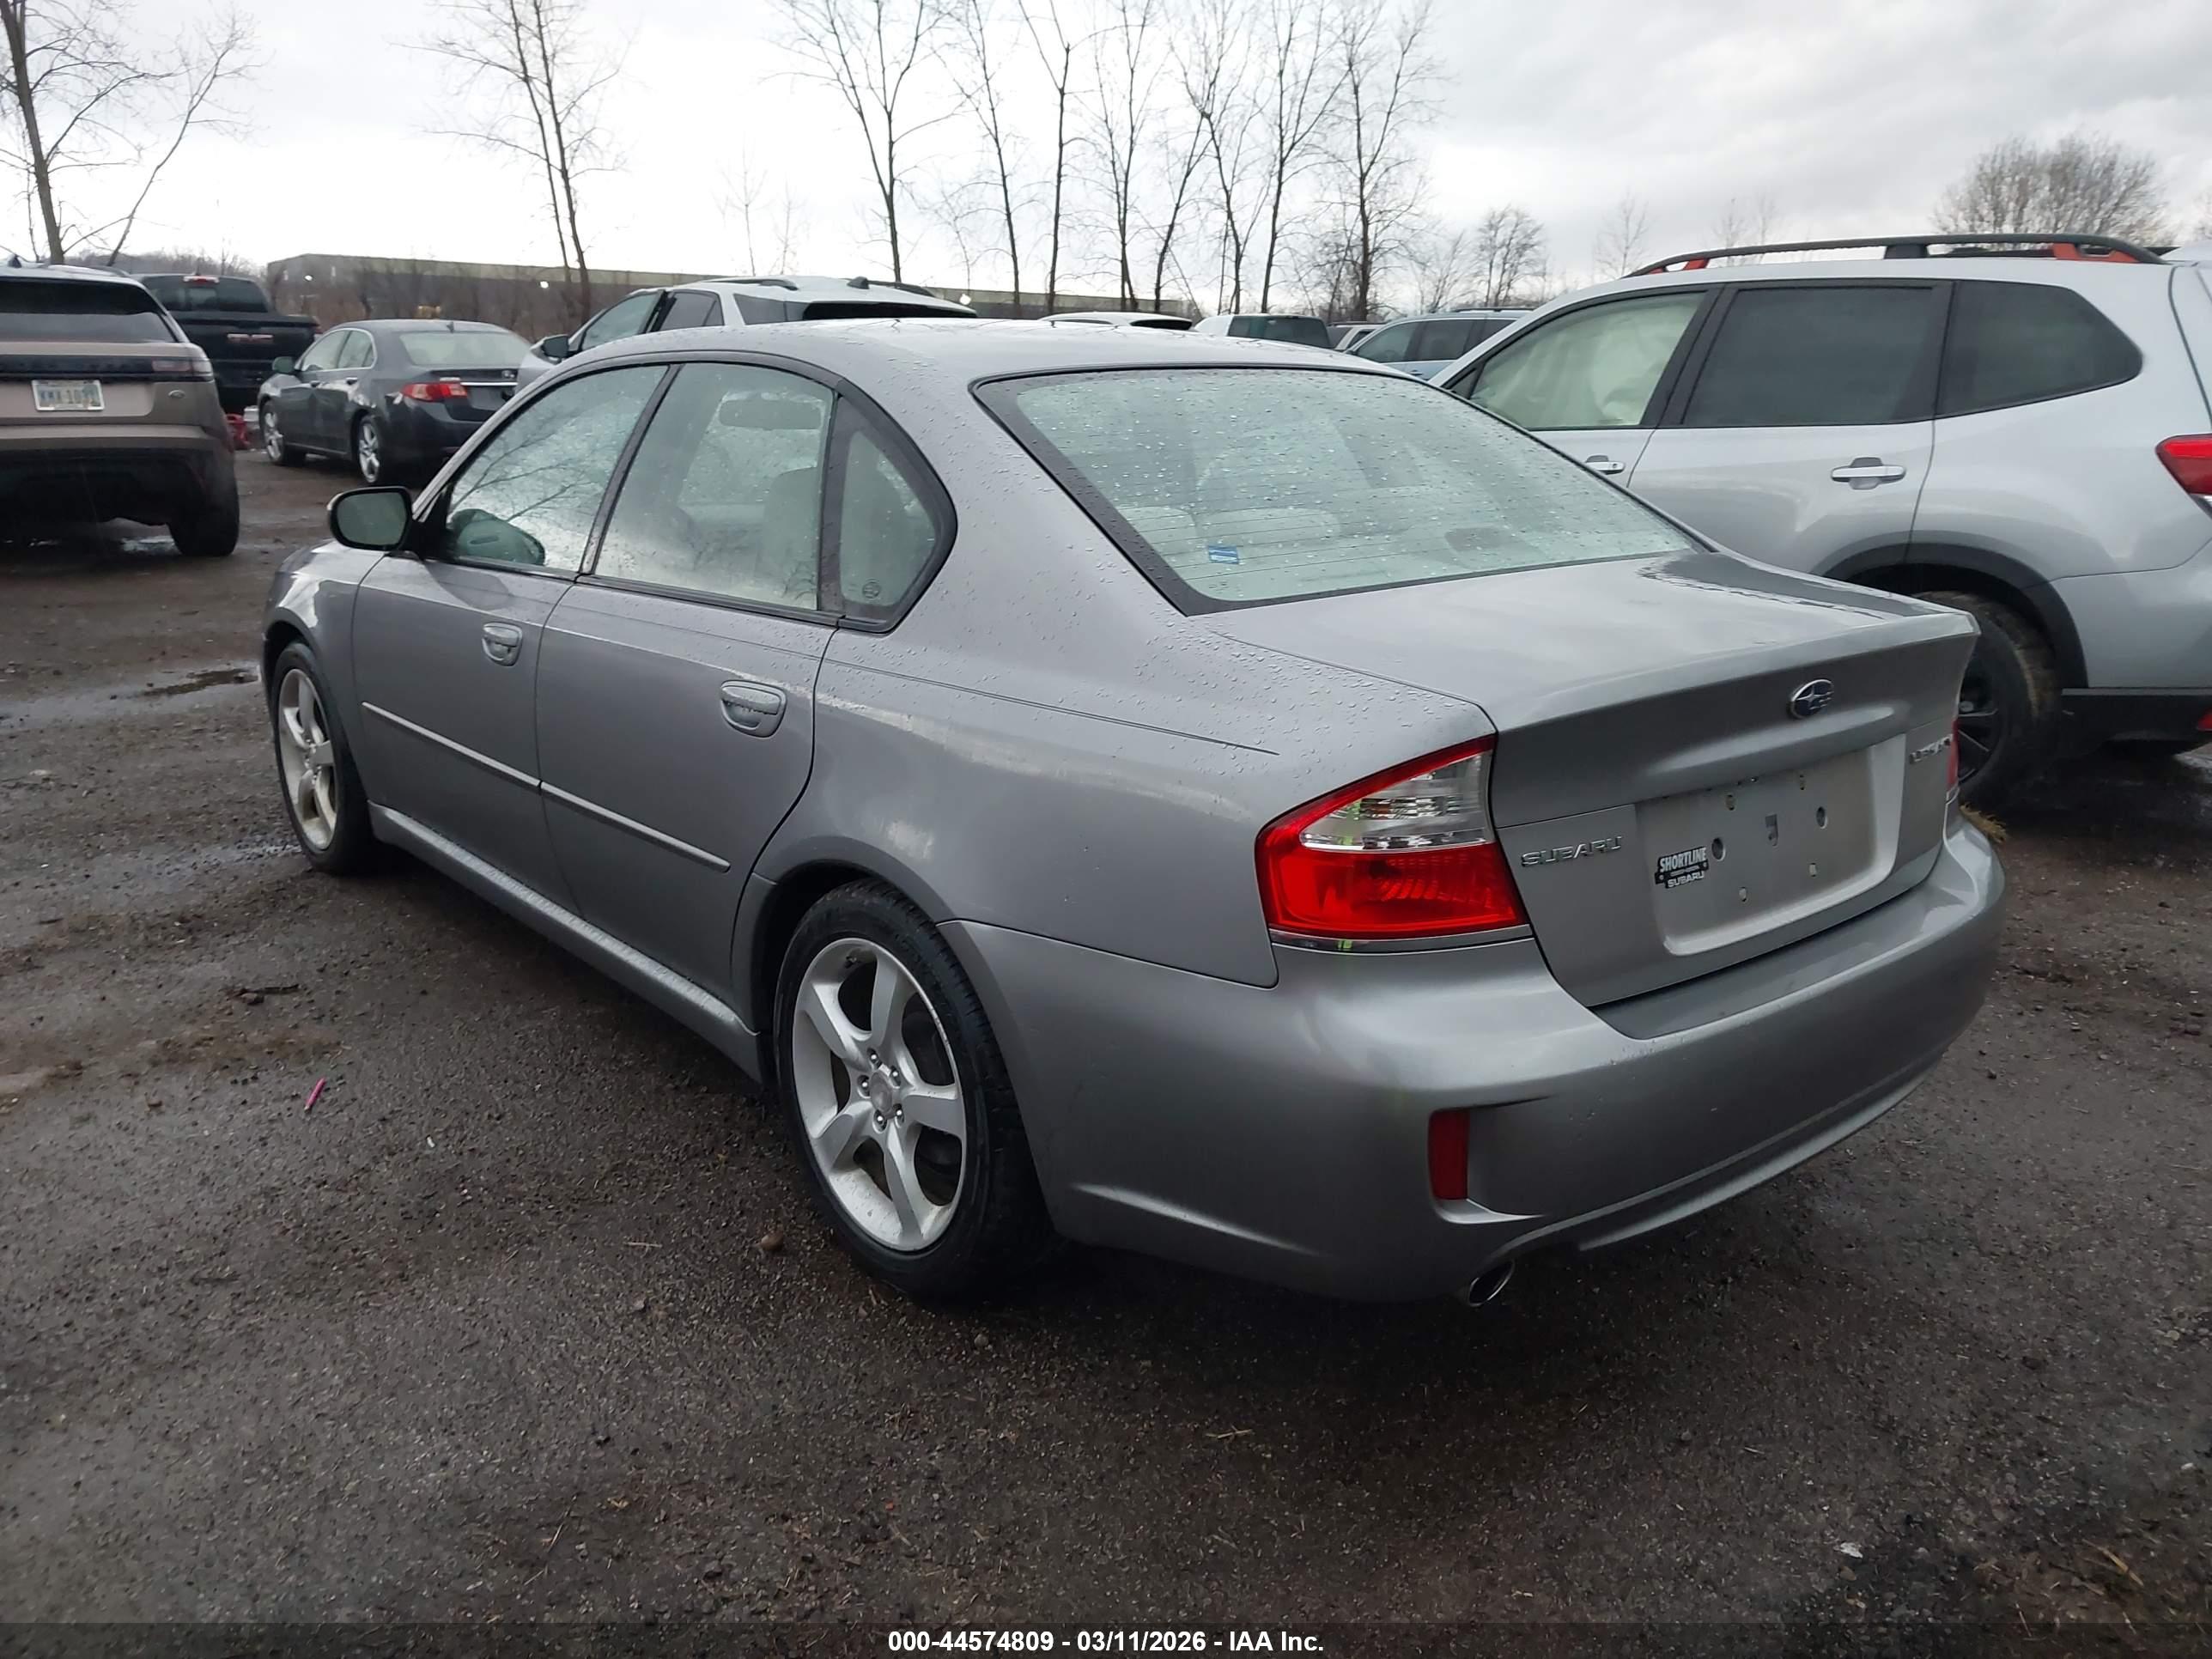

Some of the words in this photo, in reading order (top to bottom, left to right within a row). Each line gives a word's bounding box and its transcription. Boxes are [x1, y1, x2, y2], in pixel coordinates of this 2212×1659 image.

[1521, 836, 1622, 866] SUBARU
[1659, 847, 1707, 873] SHORTLINE
[1667, 870, 1705, 888] SUBARU
